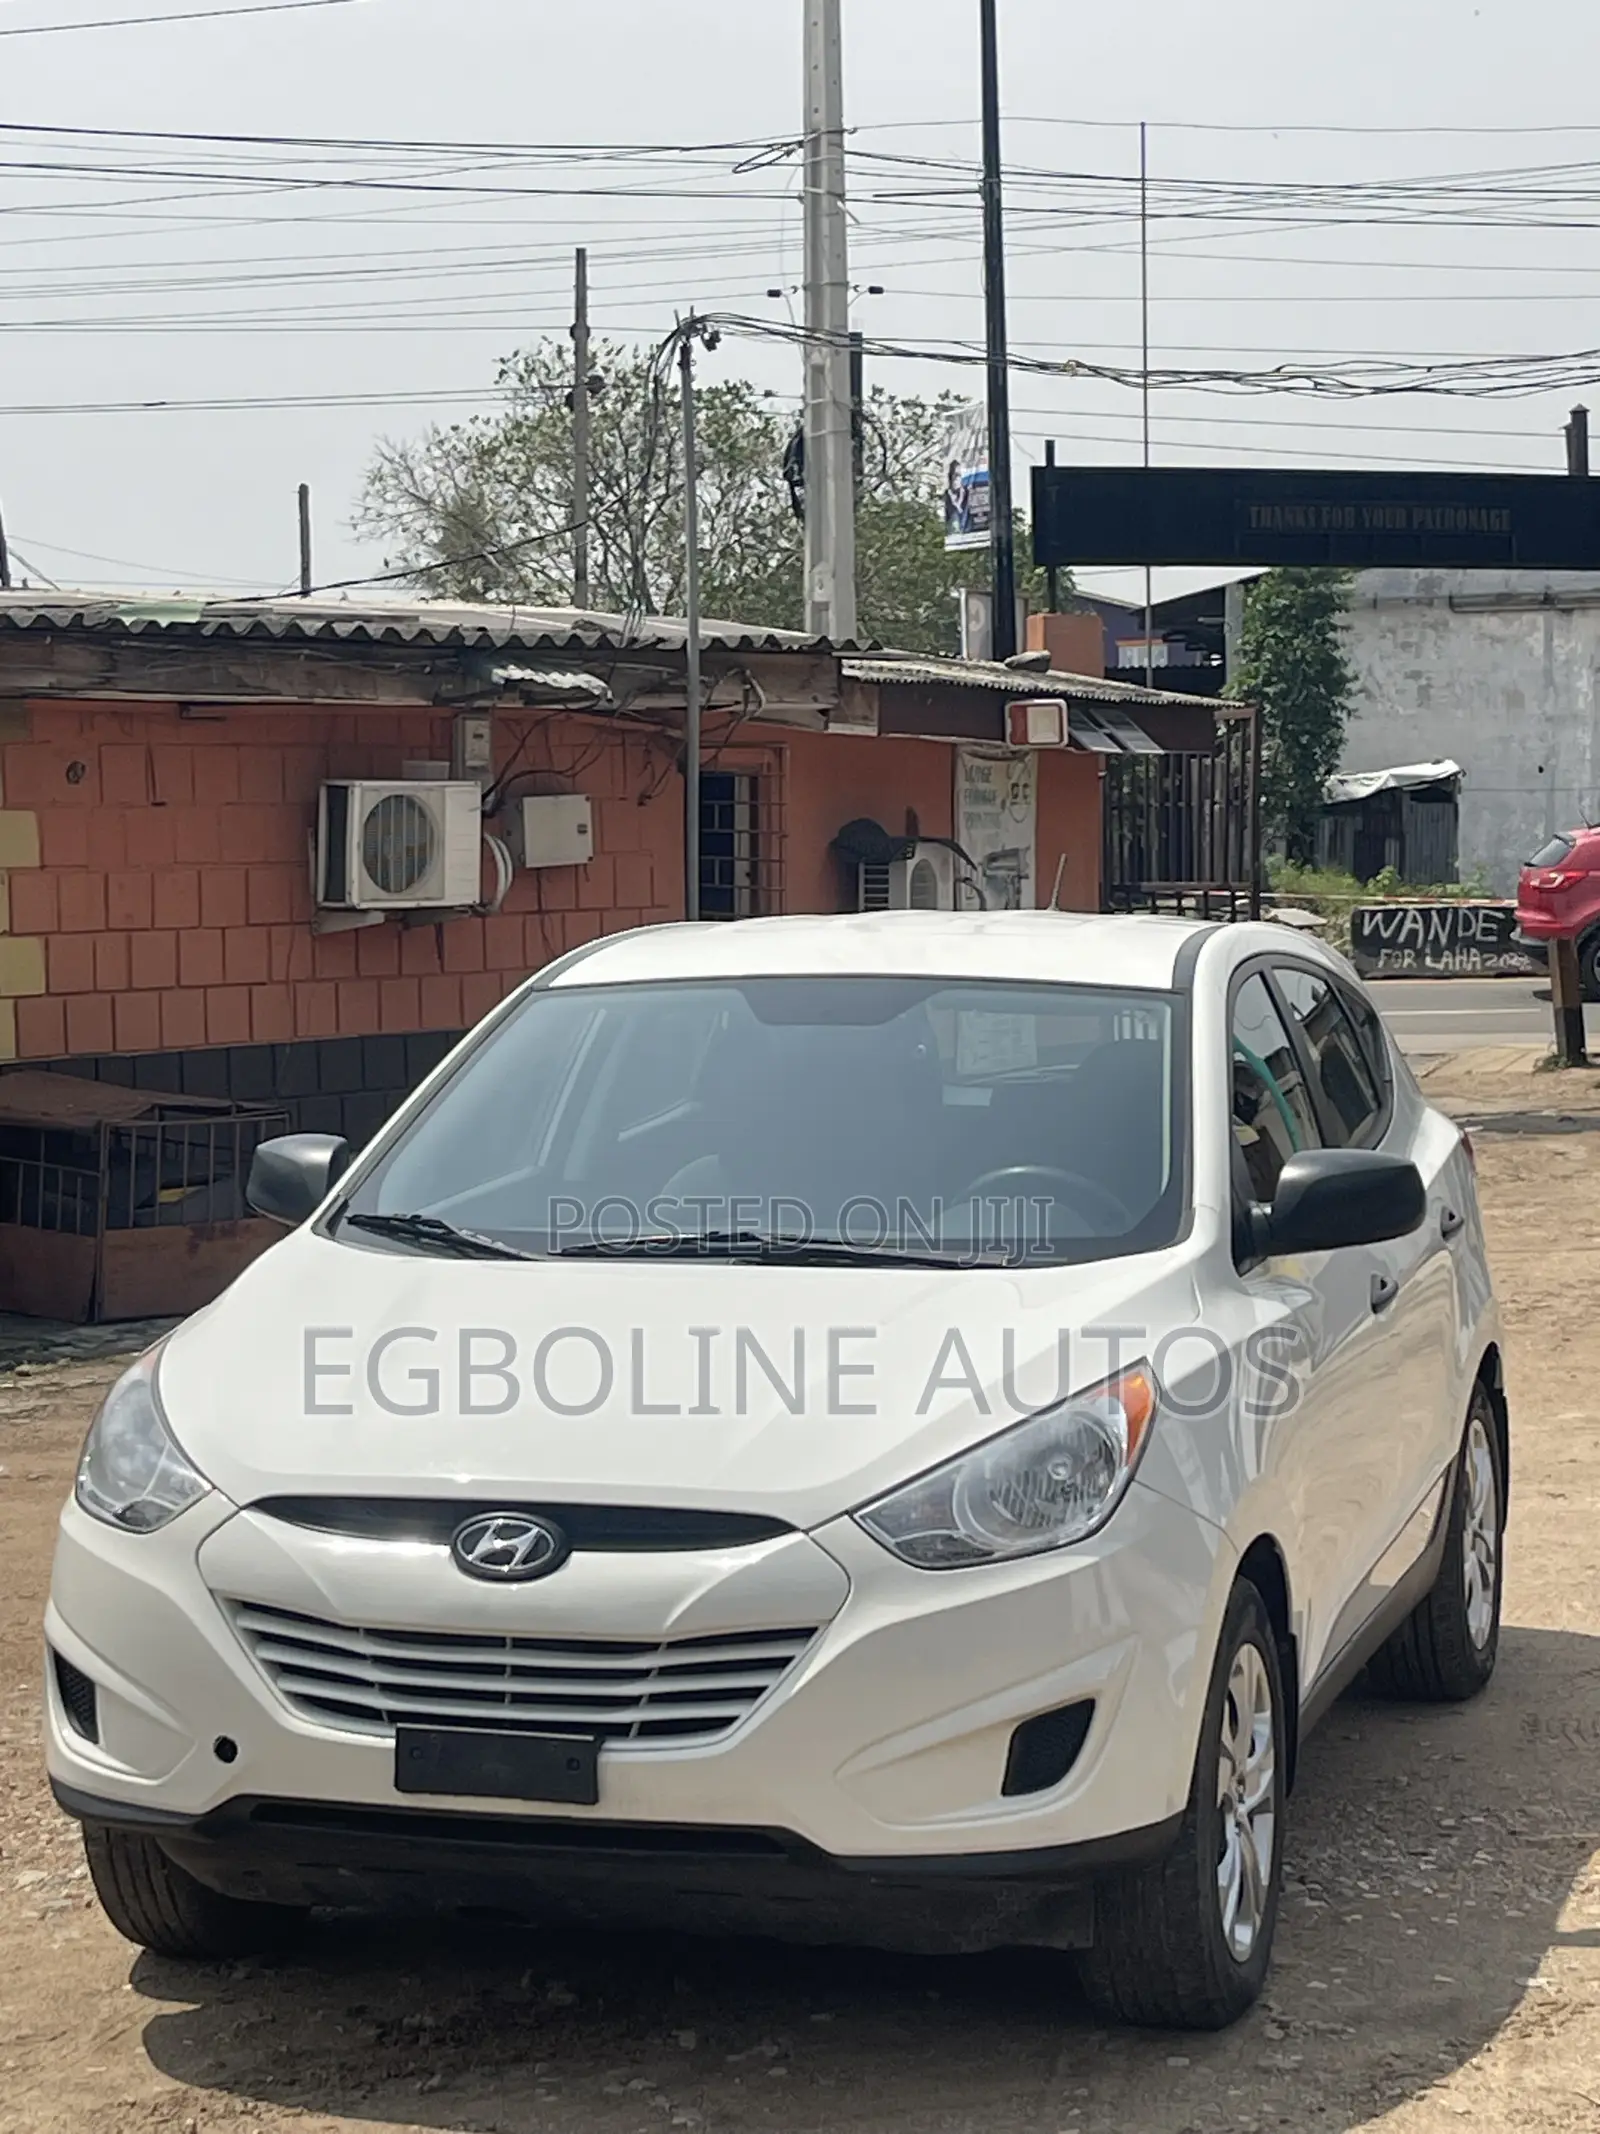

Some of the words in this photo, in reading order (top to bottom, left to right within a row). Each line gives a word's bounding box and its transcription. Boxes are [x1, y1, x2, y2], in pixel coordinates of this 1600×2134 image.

[1250, 505, 1316, 531] THANKS
[1321, 505, 1356, 530] FOR
[1362, 908, 1506, 949] WANDE
[1377, 948, 1417, 969] FOR
